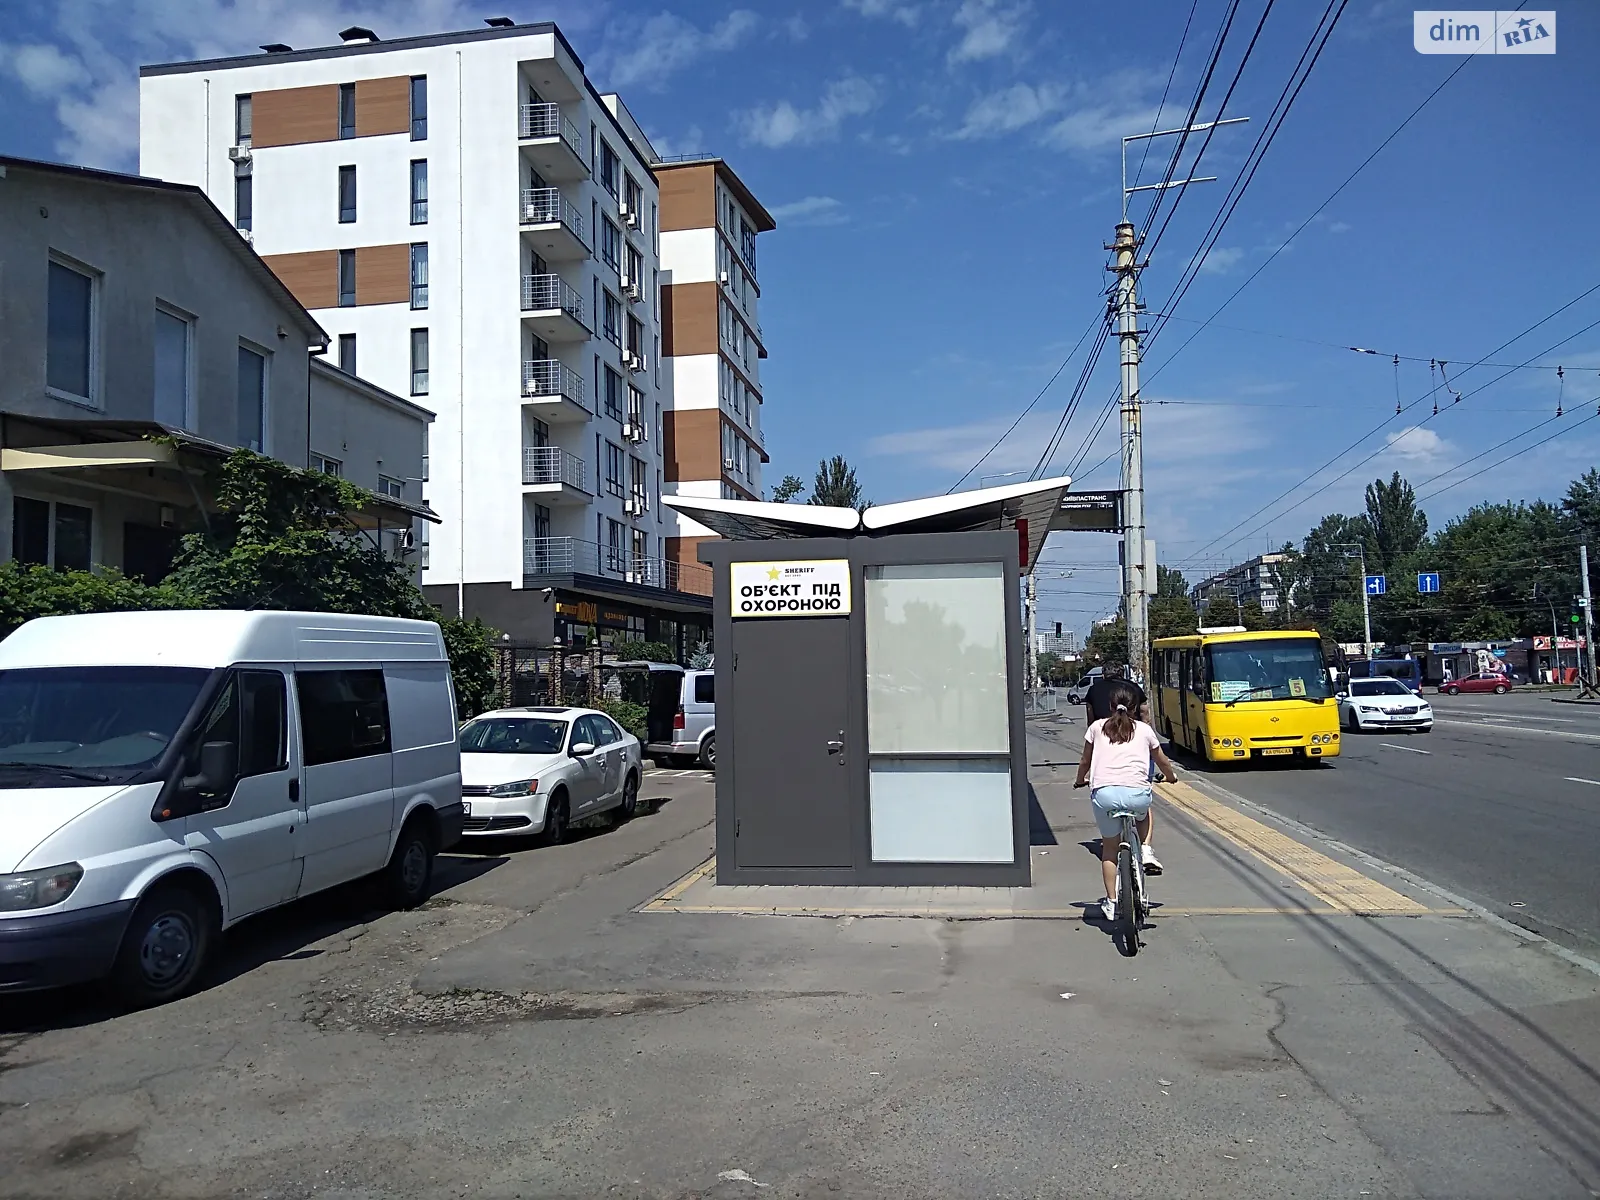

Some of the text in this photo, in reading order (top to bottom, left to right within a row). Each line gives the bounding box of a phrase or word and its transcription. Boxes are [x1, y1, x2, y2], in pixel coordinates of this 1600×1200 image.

[812, 583, 841, 597] ПІД
[741, 598, 841, 612] ОХОРОНОЮ
[1293, 682, 1302, 694] 5
